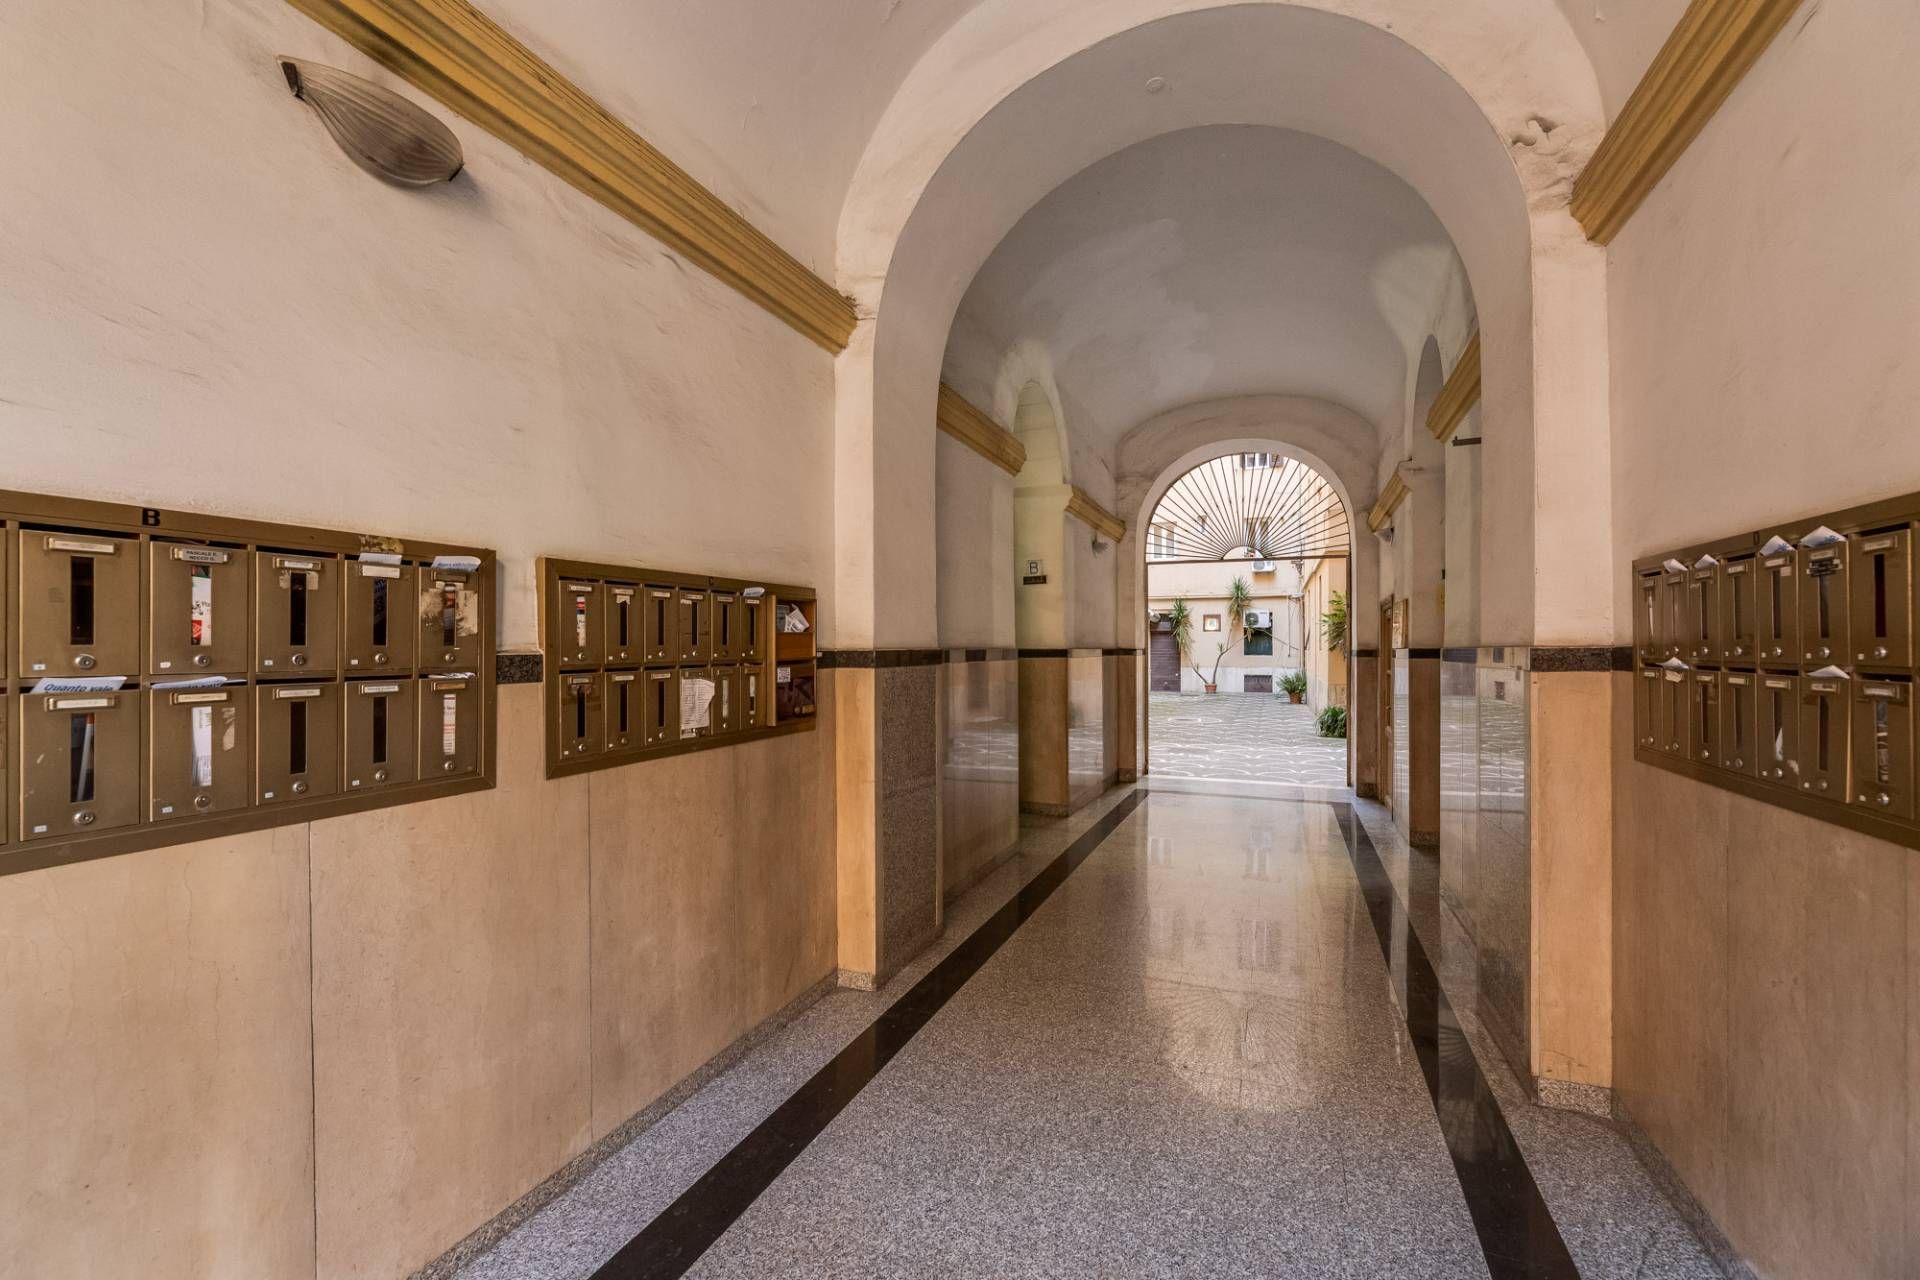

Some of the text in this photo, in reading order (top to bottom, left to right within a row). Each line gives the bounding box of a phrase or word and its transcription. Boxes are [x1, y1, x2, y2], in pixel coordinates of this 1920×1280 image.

[142, 508, 160, 526] B
[1030, 562, 1038, 575] B
[44, 683, 87, 693] Quanto
